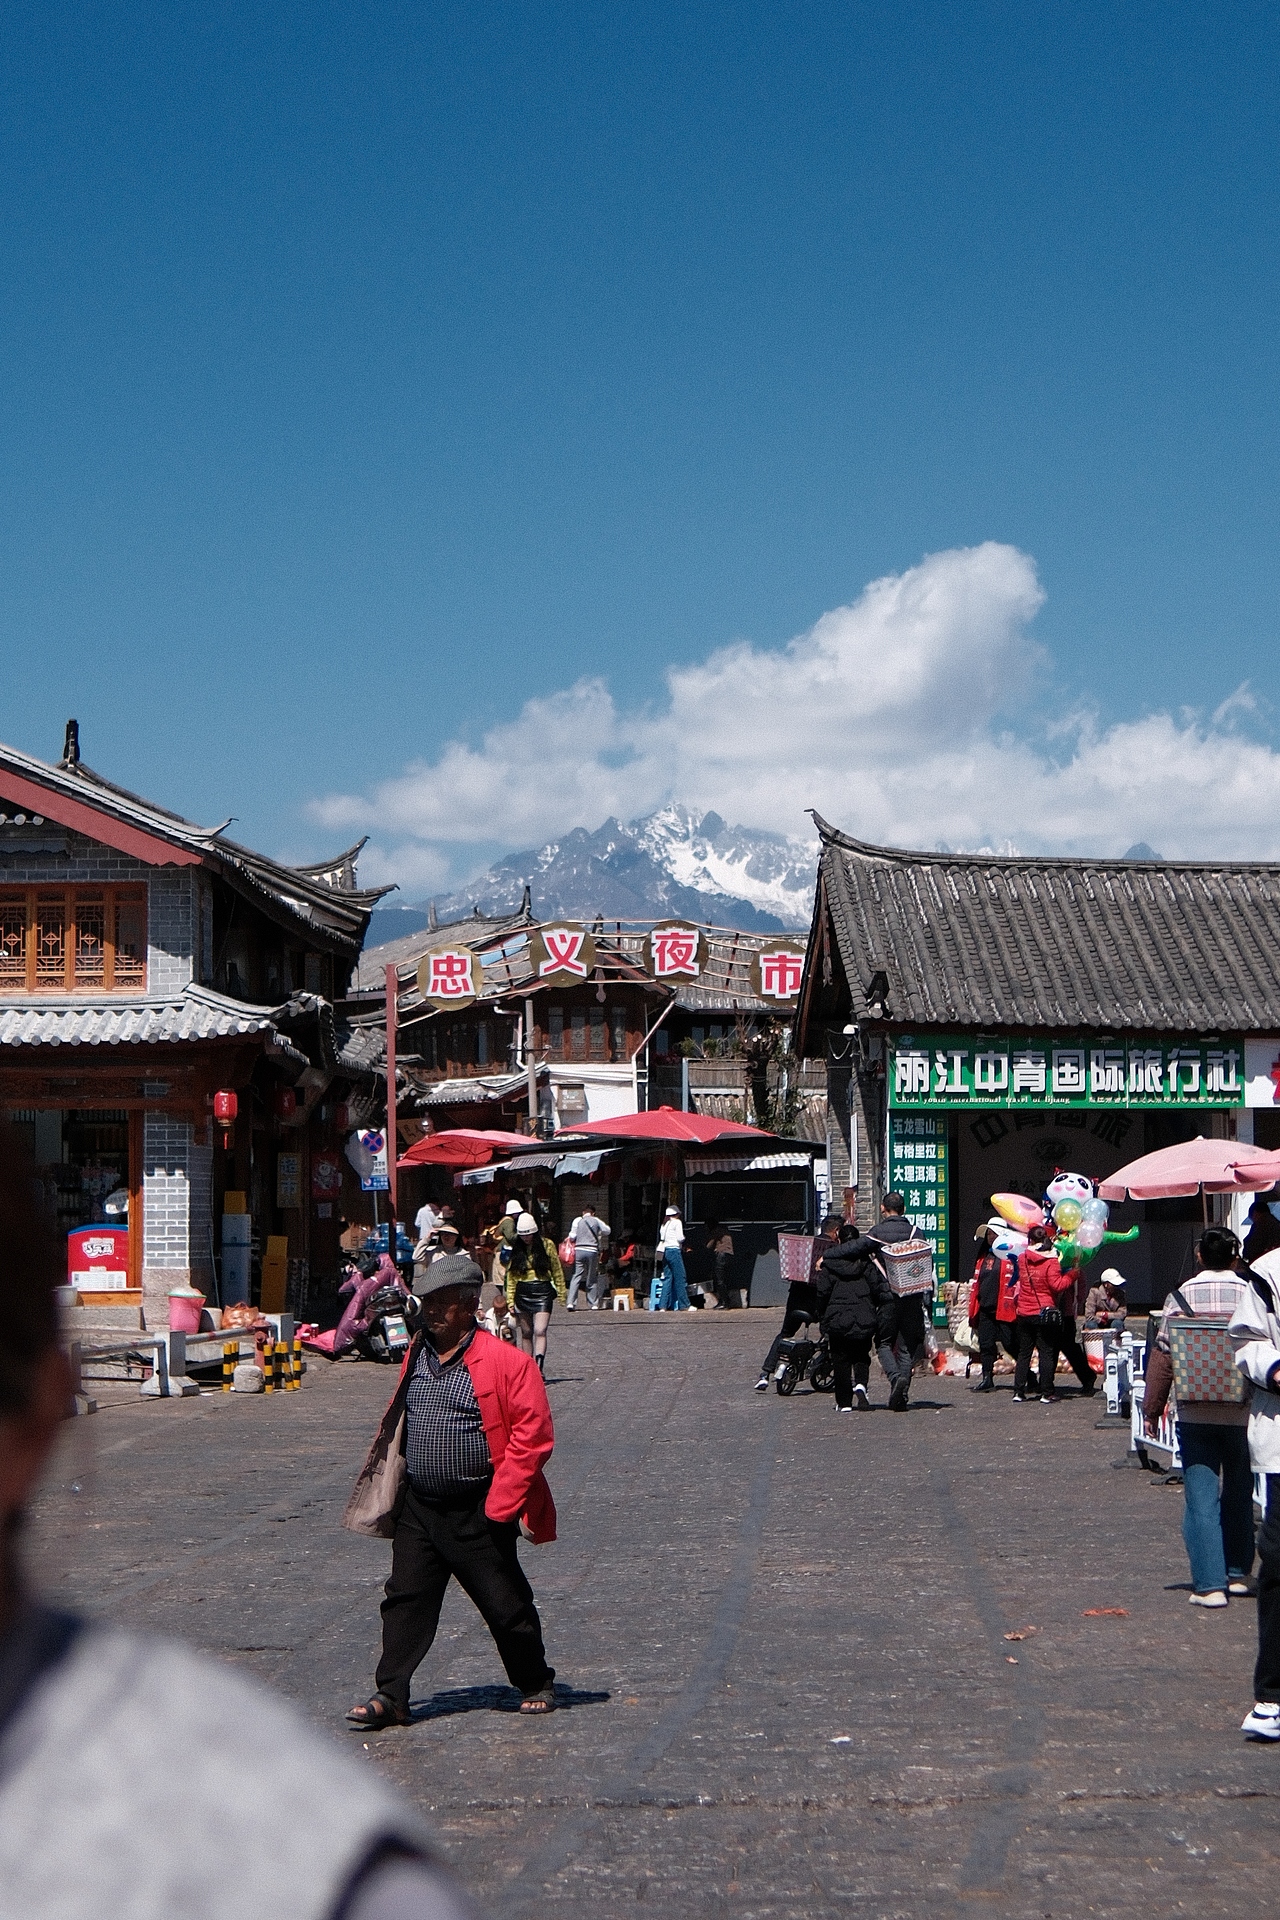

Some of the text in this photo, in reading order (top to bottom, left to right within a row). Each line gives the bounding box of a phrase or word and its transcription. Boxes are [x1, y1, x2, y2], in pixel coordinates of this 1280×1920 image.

[427, 928, 805, 999] 忠义夜市
[895, 1048, 1241, 1093] 丽江中青国际旅行社
[895, 1095, 918, 1103] China
[893, 1118, 935, 1135] 玉龙雪山
[893, 1142, 936, 1159] 香格里拉
[893, 1165, 936, 1183] 大理洱海
